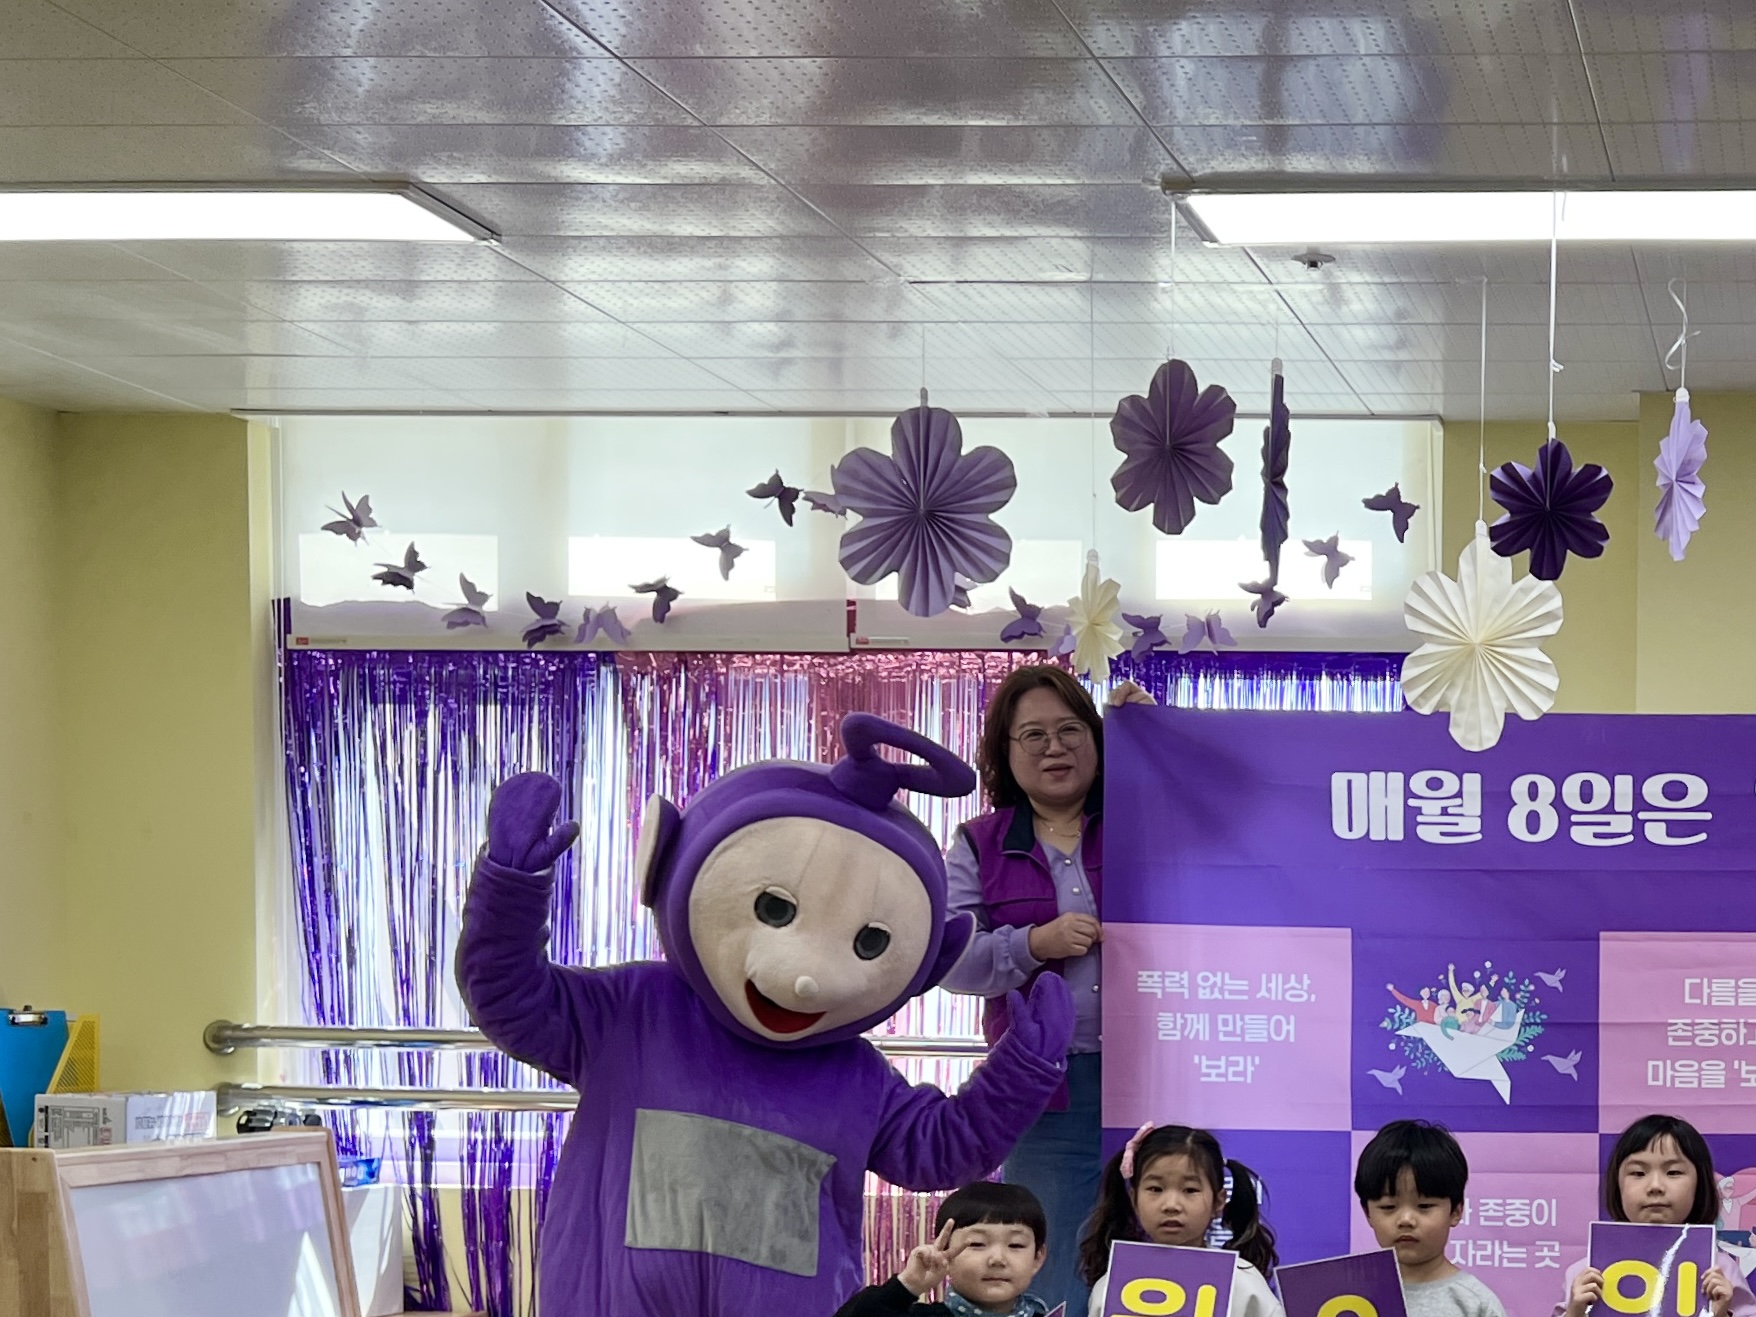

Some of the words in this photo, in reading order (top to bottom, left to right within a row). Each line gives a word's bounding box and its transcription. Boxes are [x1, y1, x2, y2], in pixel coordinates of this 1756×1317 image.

[1331, 769, 1484, 844] 매월
[1506, 771, 1714, 847] 8일은
[1136, 971, 1191, 1001] 폭력
[1196, 971, 1250, 1002] 없는
[1255, 973, 1316, 1004] 세상,
[1156, 1012, 1211, 1043] 함께
[1216, 1013, 1296, 1044] 만들어
[1193, 1054, 1261, 1085] '보라'
[1646, 1059, 1726, 1090] 마음을
[1477, 1198, 1558, 1228] 존중이
[1533, 1239, 1561, 1270] 곳
